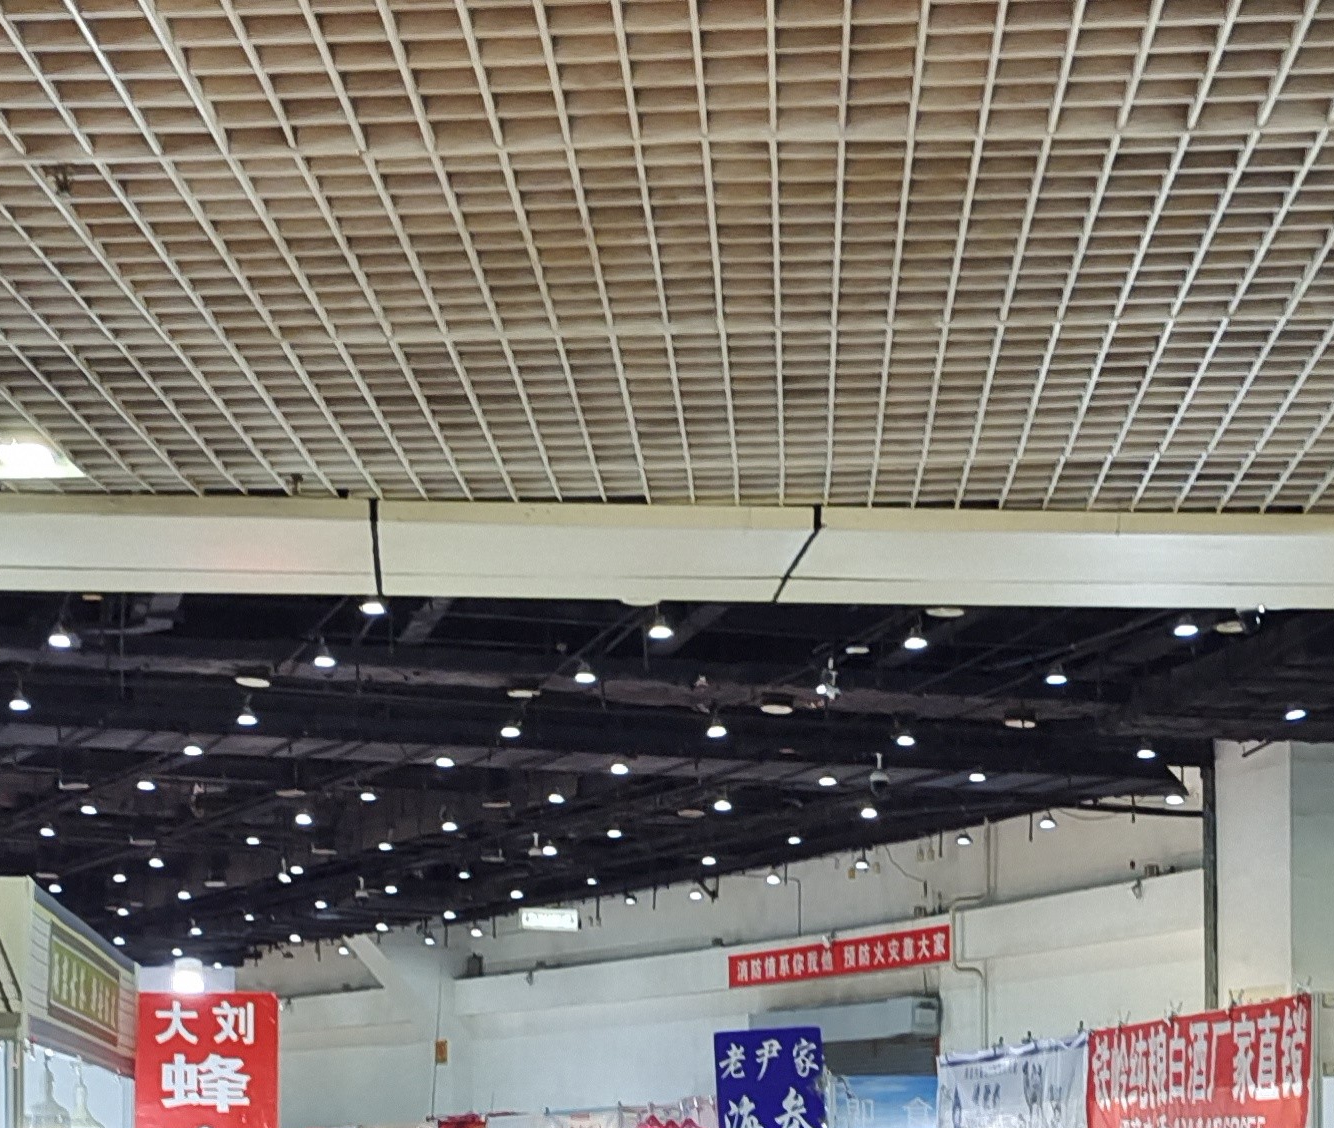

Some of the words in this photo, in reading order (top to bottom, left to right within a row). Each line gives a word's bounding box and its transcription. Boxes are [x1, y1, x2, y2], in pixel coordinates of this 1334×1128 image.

[155, 1001, 255, 1045] 大刘
[719, 1037, 822, 1081] 老尹家
[1091, 1000, 1307, 1112] 铁岭纯粮白酒厂家直销
